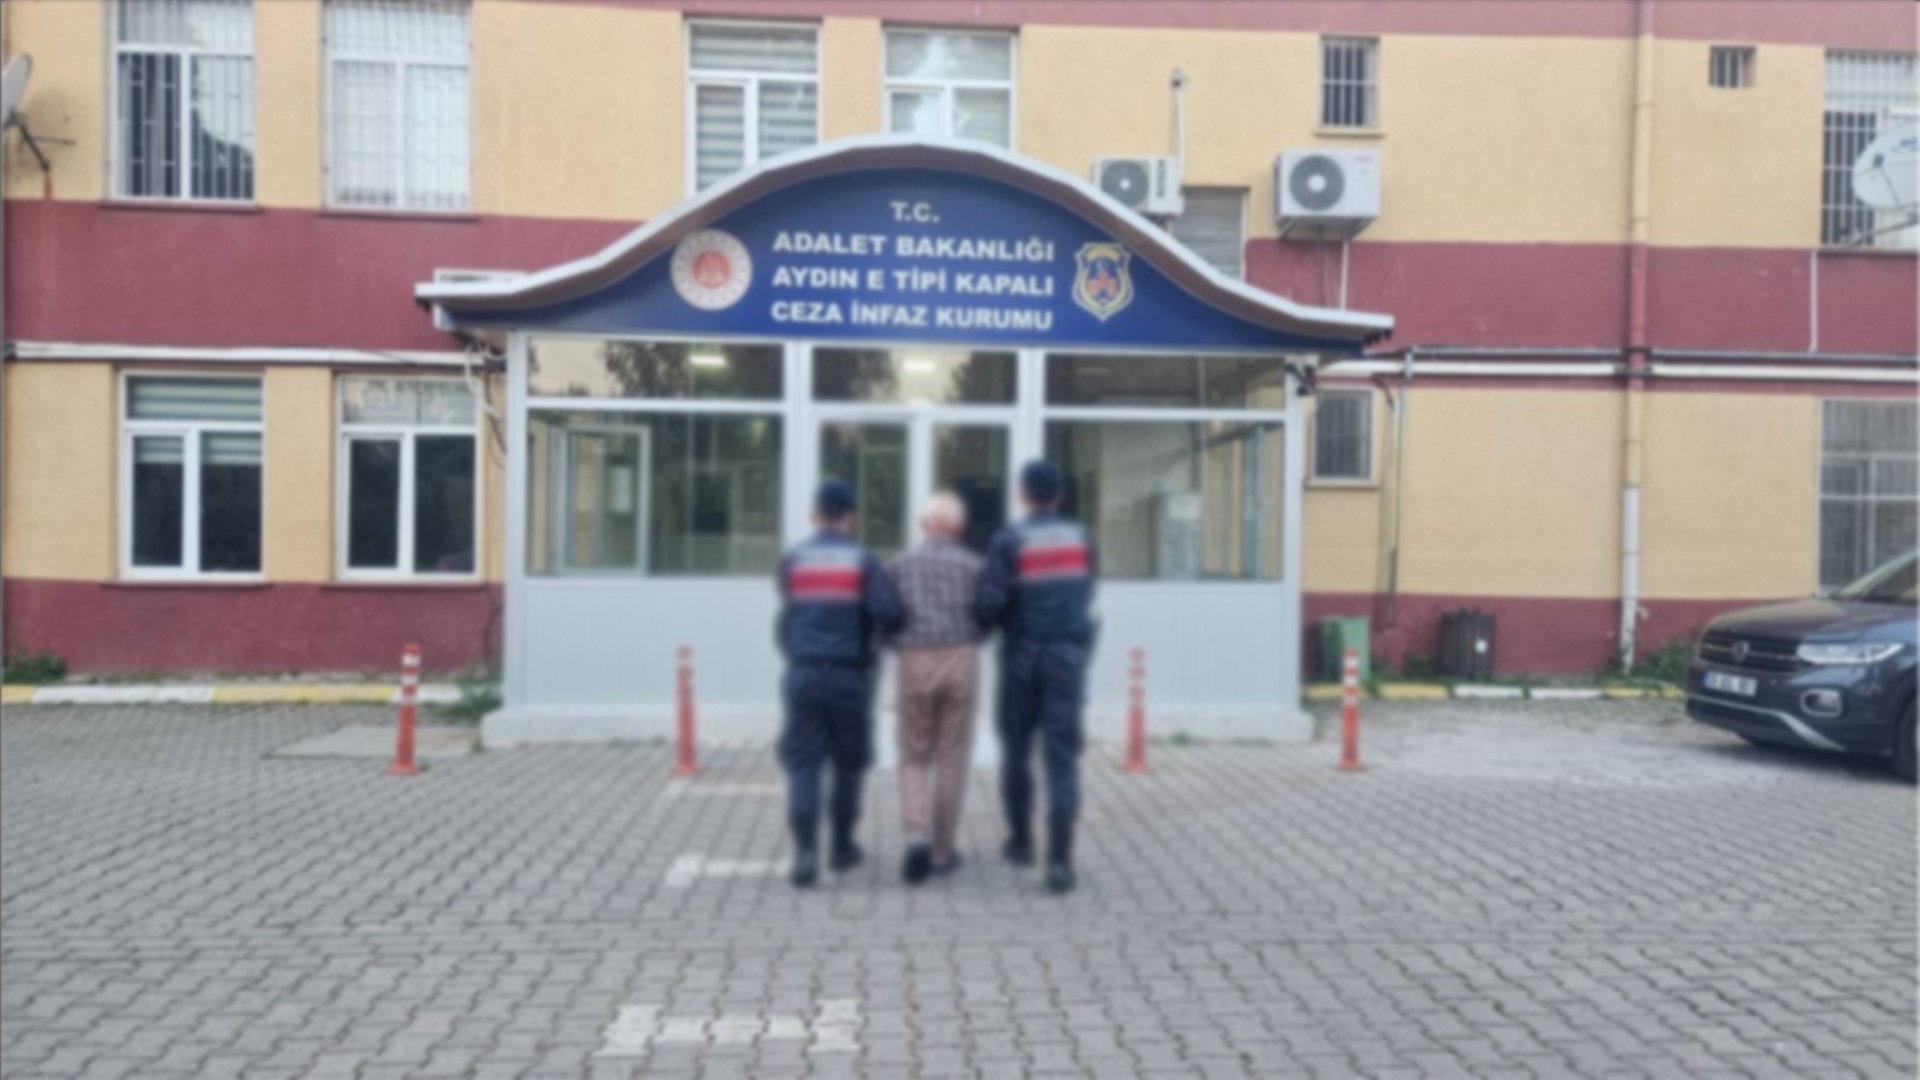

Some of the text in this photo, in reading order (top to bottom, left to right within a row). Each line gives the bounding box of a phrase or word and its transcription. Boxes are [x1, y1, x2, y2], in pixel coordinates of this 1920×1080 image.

[891, 202, 940, 222] T.C.
[773, 232, 1054, 261] ADALET BAKANLIĞI
[772, 266, 1054, 296] AYDIN E TİPİ KAPALI
[771, 300, 1053, 331] CEZA İNFAZ KURUMU
